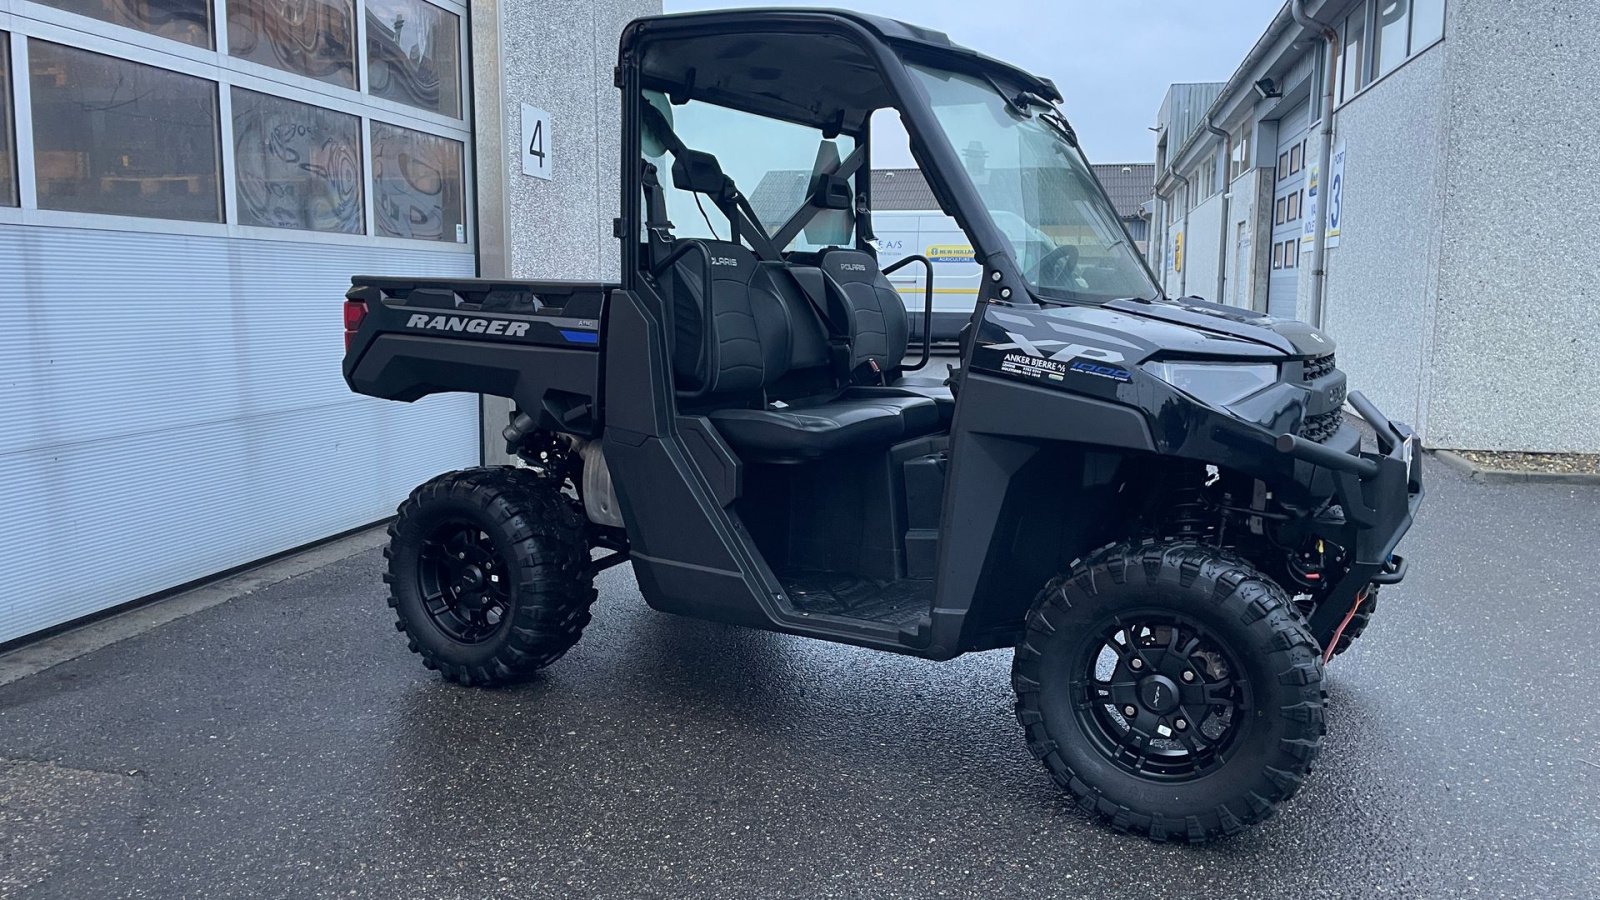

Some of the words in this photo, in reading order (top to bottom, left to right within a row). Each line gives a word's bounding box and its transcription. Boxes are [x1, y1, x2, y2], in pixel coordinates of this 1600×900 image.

[529, 119, 545, 168] 4
[1331, 174, 1341, 228] 3
[886, 240, 902, 249] A/S
[711, 256, 738, 267] OLARIS
[841, 263, 866, 271] POLARIS
[406, 313, 530, 337] RANGER
[982, 331, 1125, 363] XP
[1004, 353, 1031, 365] ANKER
[1031, 358, 1057, 371] BJERRE
[1071, 361, 1132, 379] 1000
